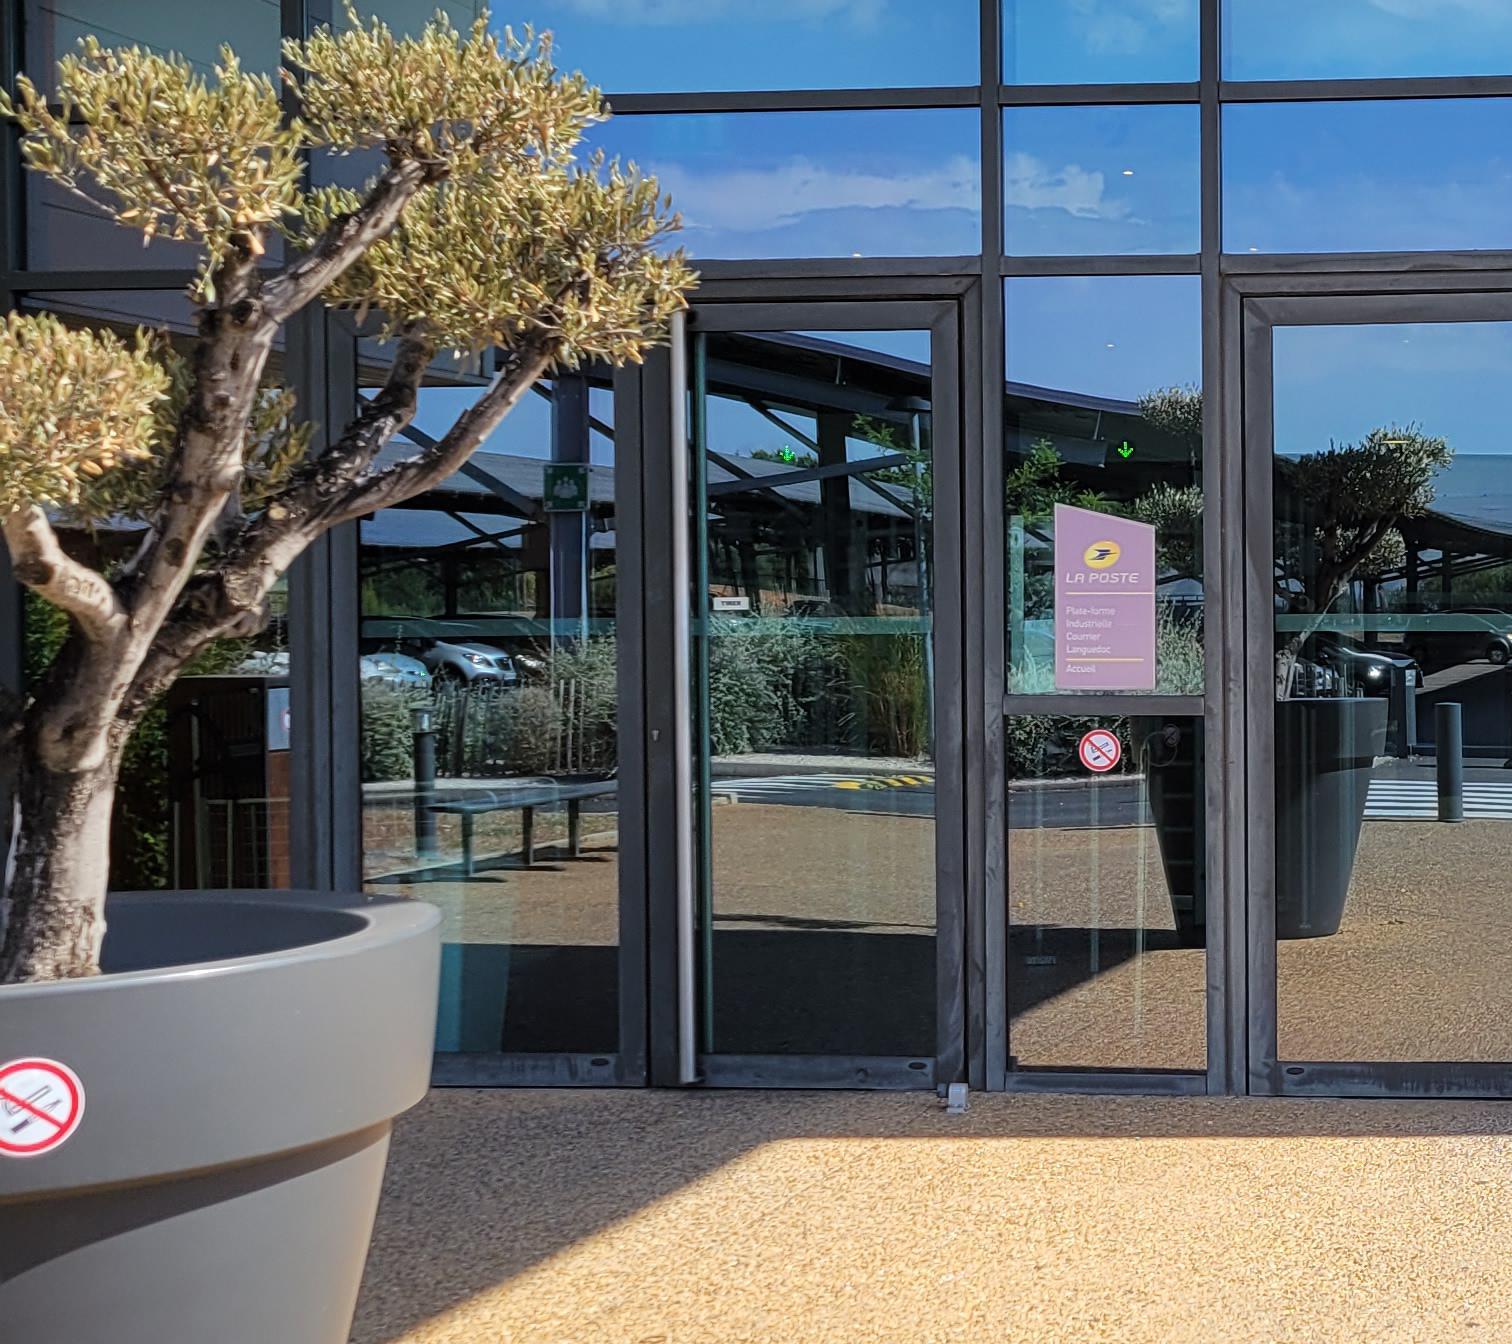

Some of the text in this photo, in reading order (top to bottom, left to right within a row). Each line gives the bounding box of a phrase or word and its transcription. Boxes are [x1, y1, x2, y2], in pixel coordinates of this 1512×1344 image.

[1066, 572, 1139, 583] LA POSTE
[1065, 643, 1112, 656] Languedoc
[1065, 663, 1097, 673] Accueil
